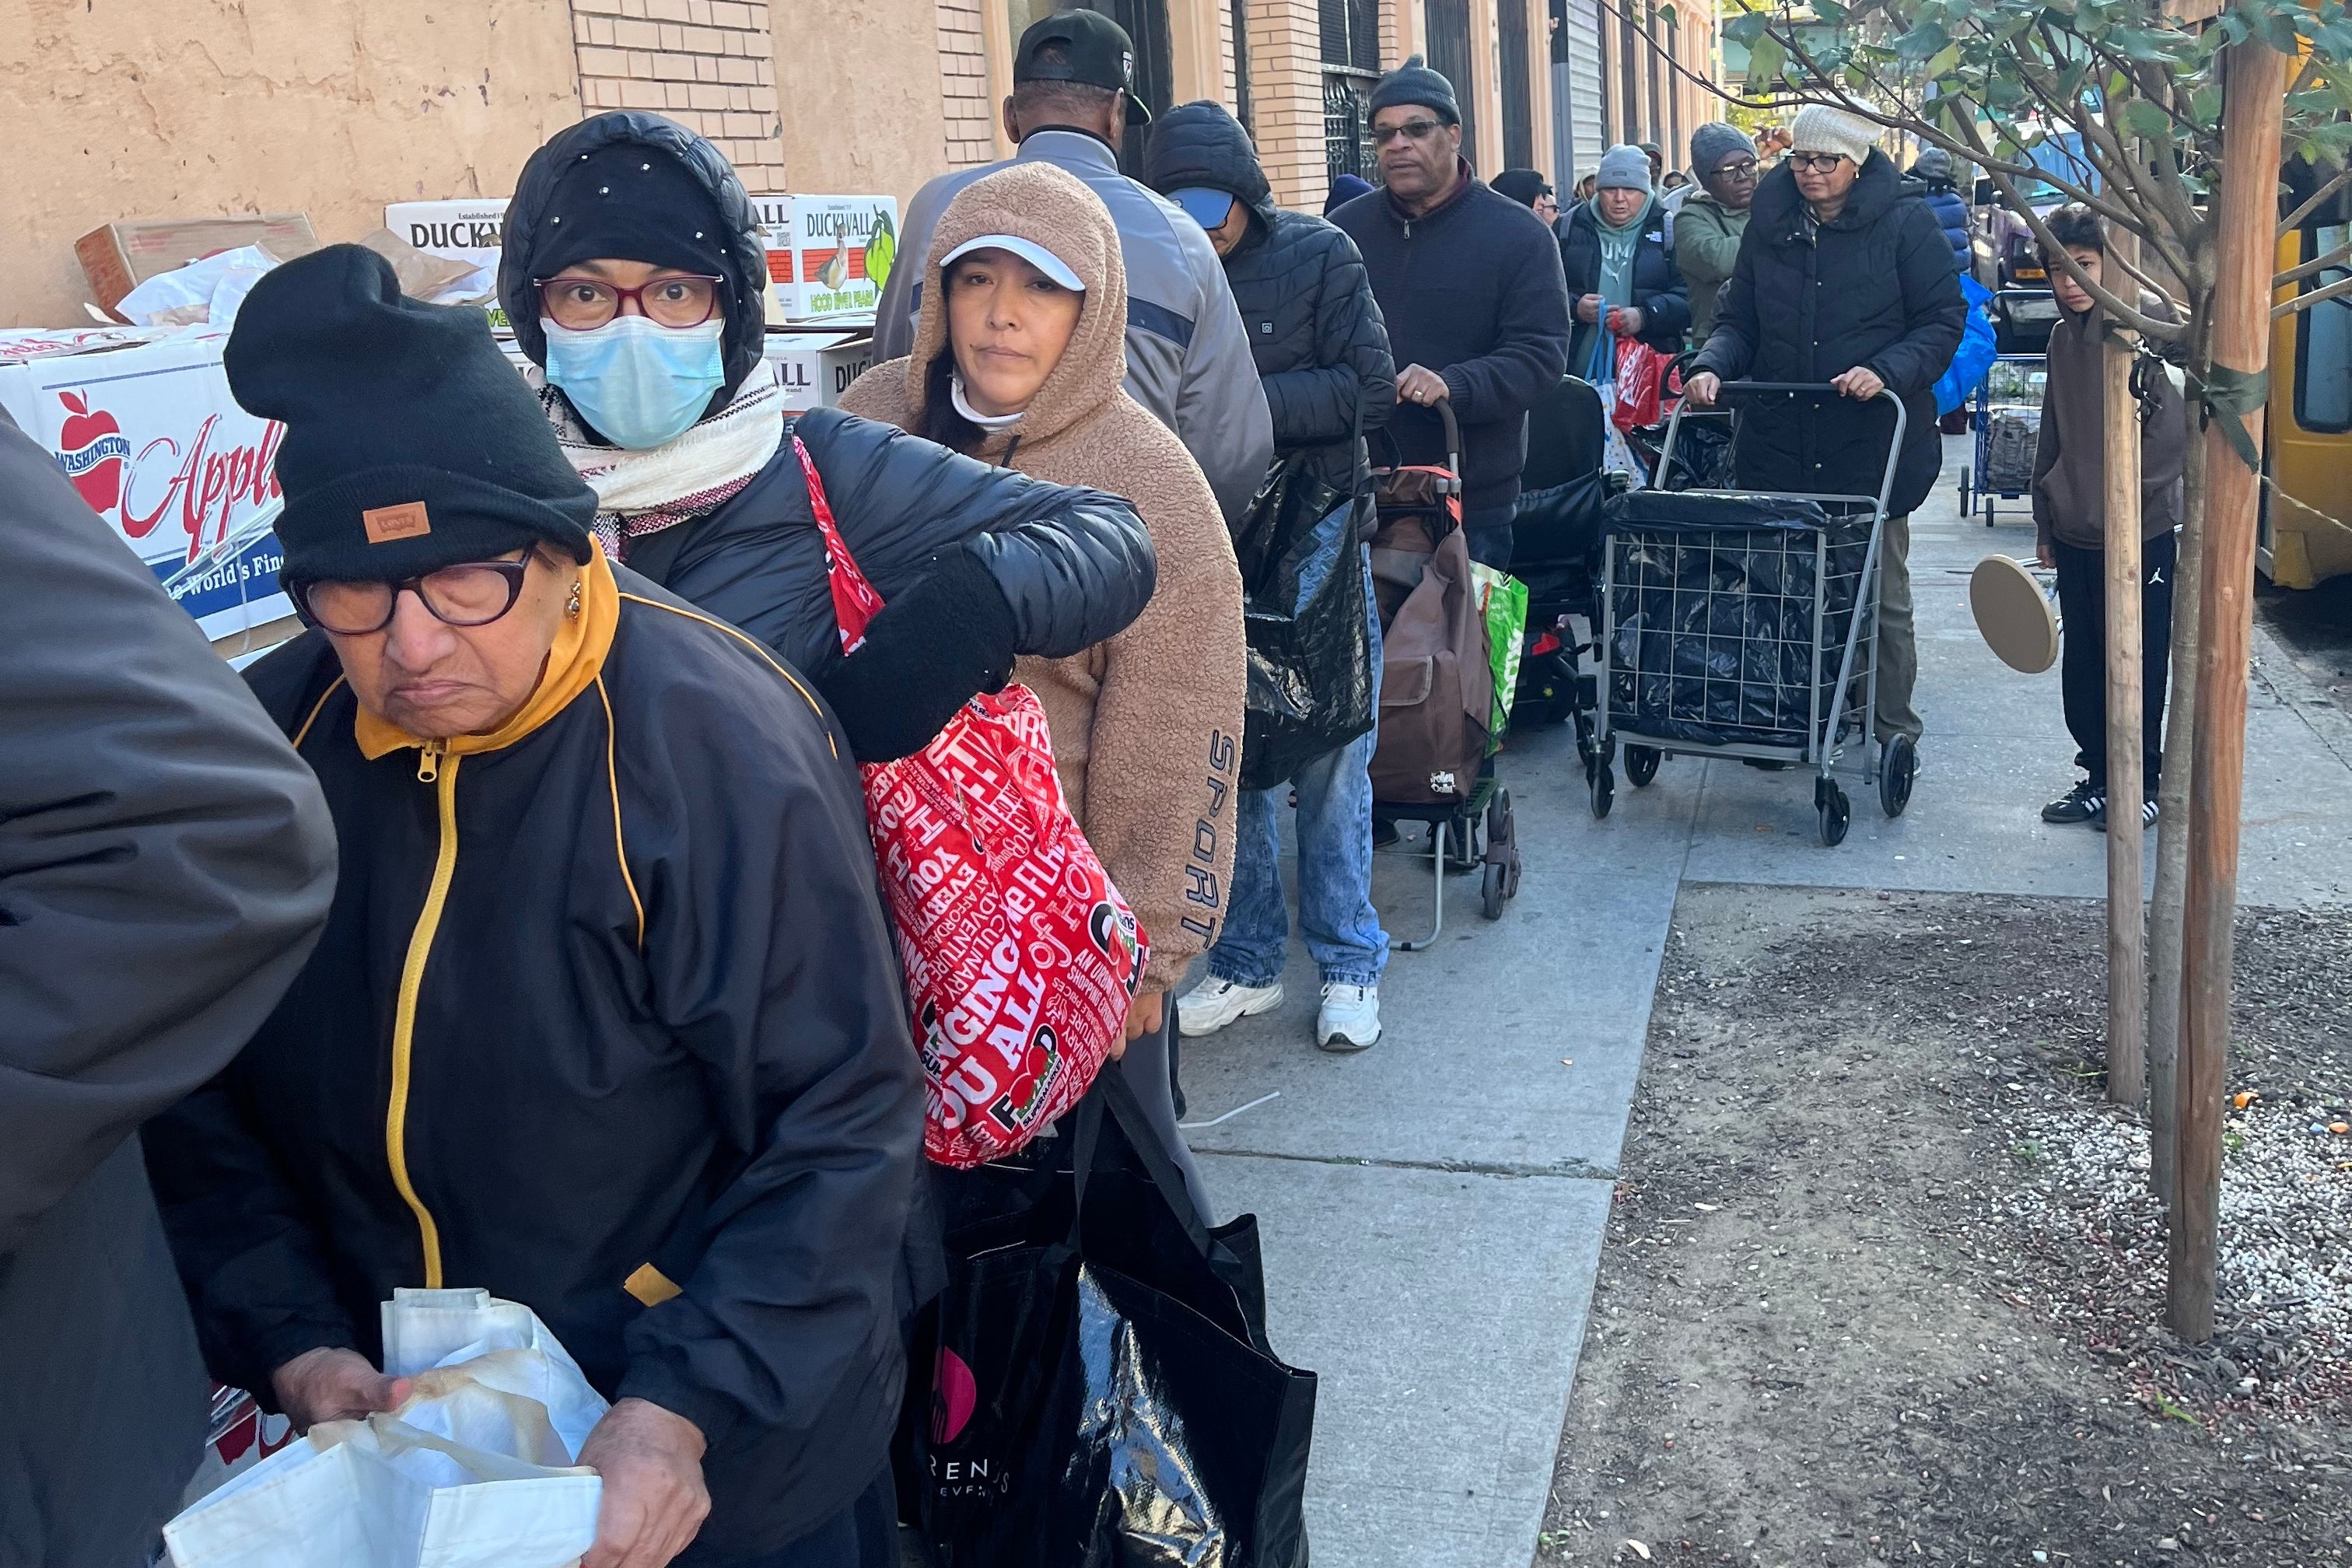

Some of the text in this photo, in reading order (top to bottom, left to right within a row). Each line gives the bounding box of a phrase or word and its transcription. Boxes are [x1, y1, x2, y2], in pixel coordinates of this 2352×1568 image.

[807, 212, 872, 237] DUCKWALL
[54, 436, 131, 472] WASHINGTON
[253, 553, 285, 579] Fin
[1181, 730, 1235, 950] SPORT
[907, 846, 961, 905] YOU
[975, 873, 989, 894] AT
[929, 881, 1000, 982] ADVENTURE
[943, 914, 1005, 1002] CULINARY
[1027, 912, 1072, 970] of
[1067, 964, 1103, 1007] SHOPPING
[1074, 948, 1097, 972] AN
[985, 967, 1046, 1072] ALL
[1052, 977, 1083, 1009] PRICES
[1062, 1025, 1094, 1080] CULINARY
[1022, 1058, 1063, 1129] SUPERMARKET
